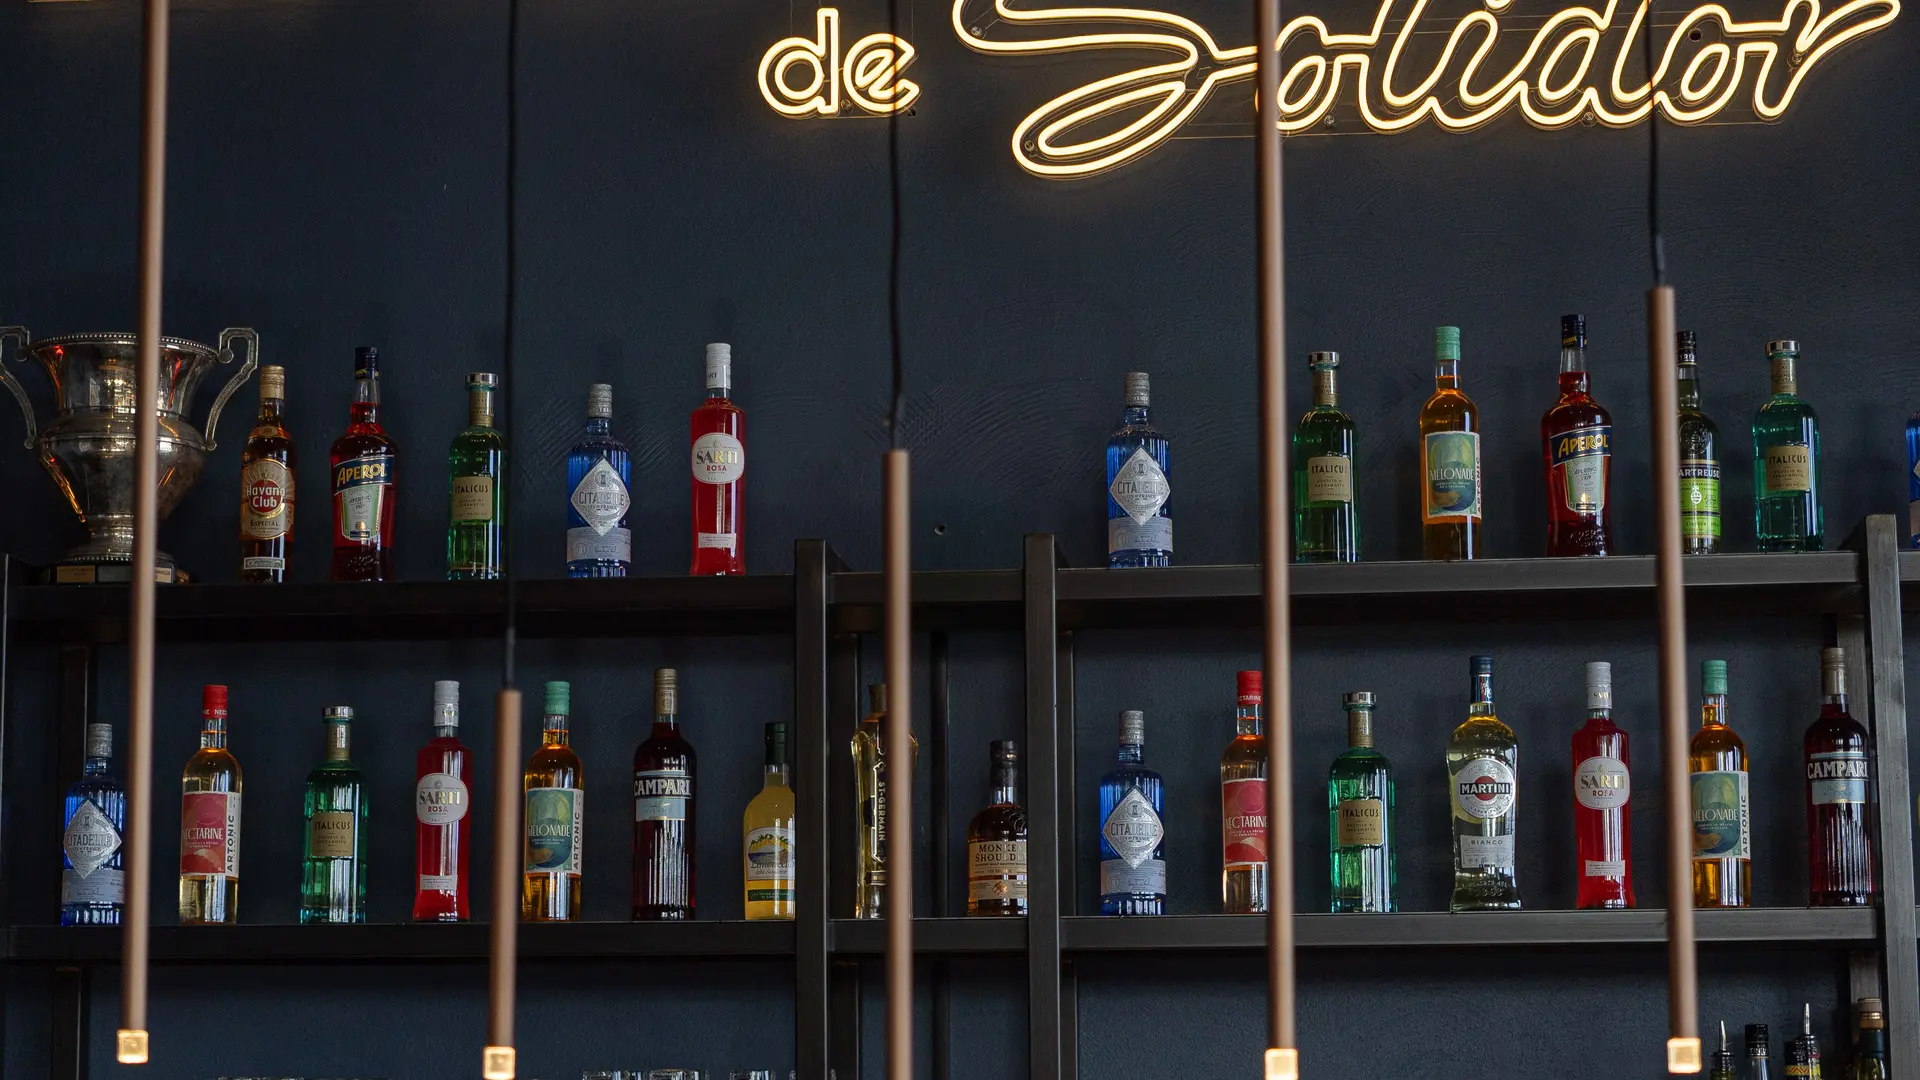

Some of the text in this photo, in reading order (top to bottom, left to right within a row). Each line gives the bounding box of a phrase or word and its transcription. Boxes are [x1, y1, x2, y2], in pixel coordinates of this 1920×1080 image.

[757, 6, 921, 118] de
[1559, 434, 1608, 457] APEROL
[696, 449, 738, 465] SARTI
[1769, 454, 1807, 465] ITALICUS
[336, 464, 387, 487] APEROL
[1431, 468, 1474, 481] MELONADE
[1679, 468, 1720, 478] ARTREUSE
[246, 485, 286, 497] Havana
[454, 484, 489, 494] ITALICUS
[1117, 481, 1165, 496] CITADELLE
[252, 496, 278, 508] Club
[250, 519, 280, 527] ESPECIAL
[1807, 762, 1869, 779] CAMPARI
[633, 779, 691, 797] CAMPARI
[1461, 783, 1510, 794] MARTINI
[1580, 775, 1625, 790] SARTI
[419, 791, 461, 805] SARTI
[878, 782, 886, 841] ST-GERMAIN
[1342, 808, 1379, 818] ITALICUS
[314, 821, 351, 831] ITALICUS
[1225, 815, 1269, 828] NECTARINE
[1110, 822, 1158, 837] CITADELLE
[227, 814, 235, 872] ARTONIC
